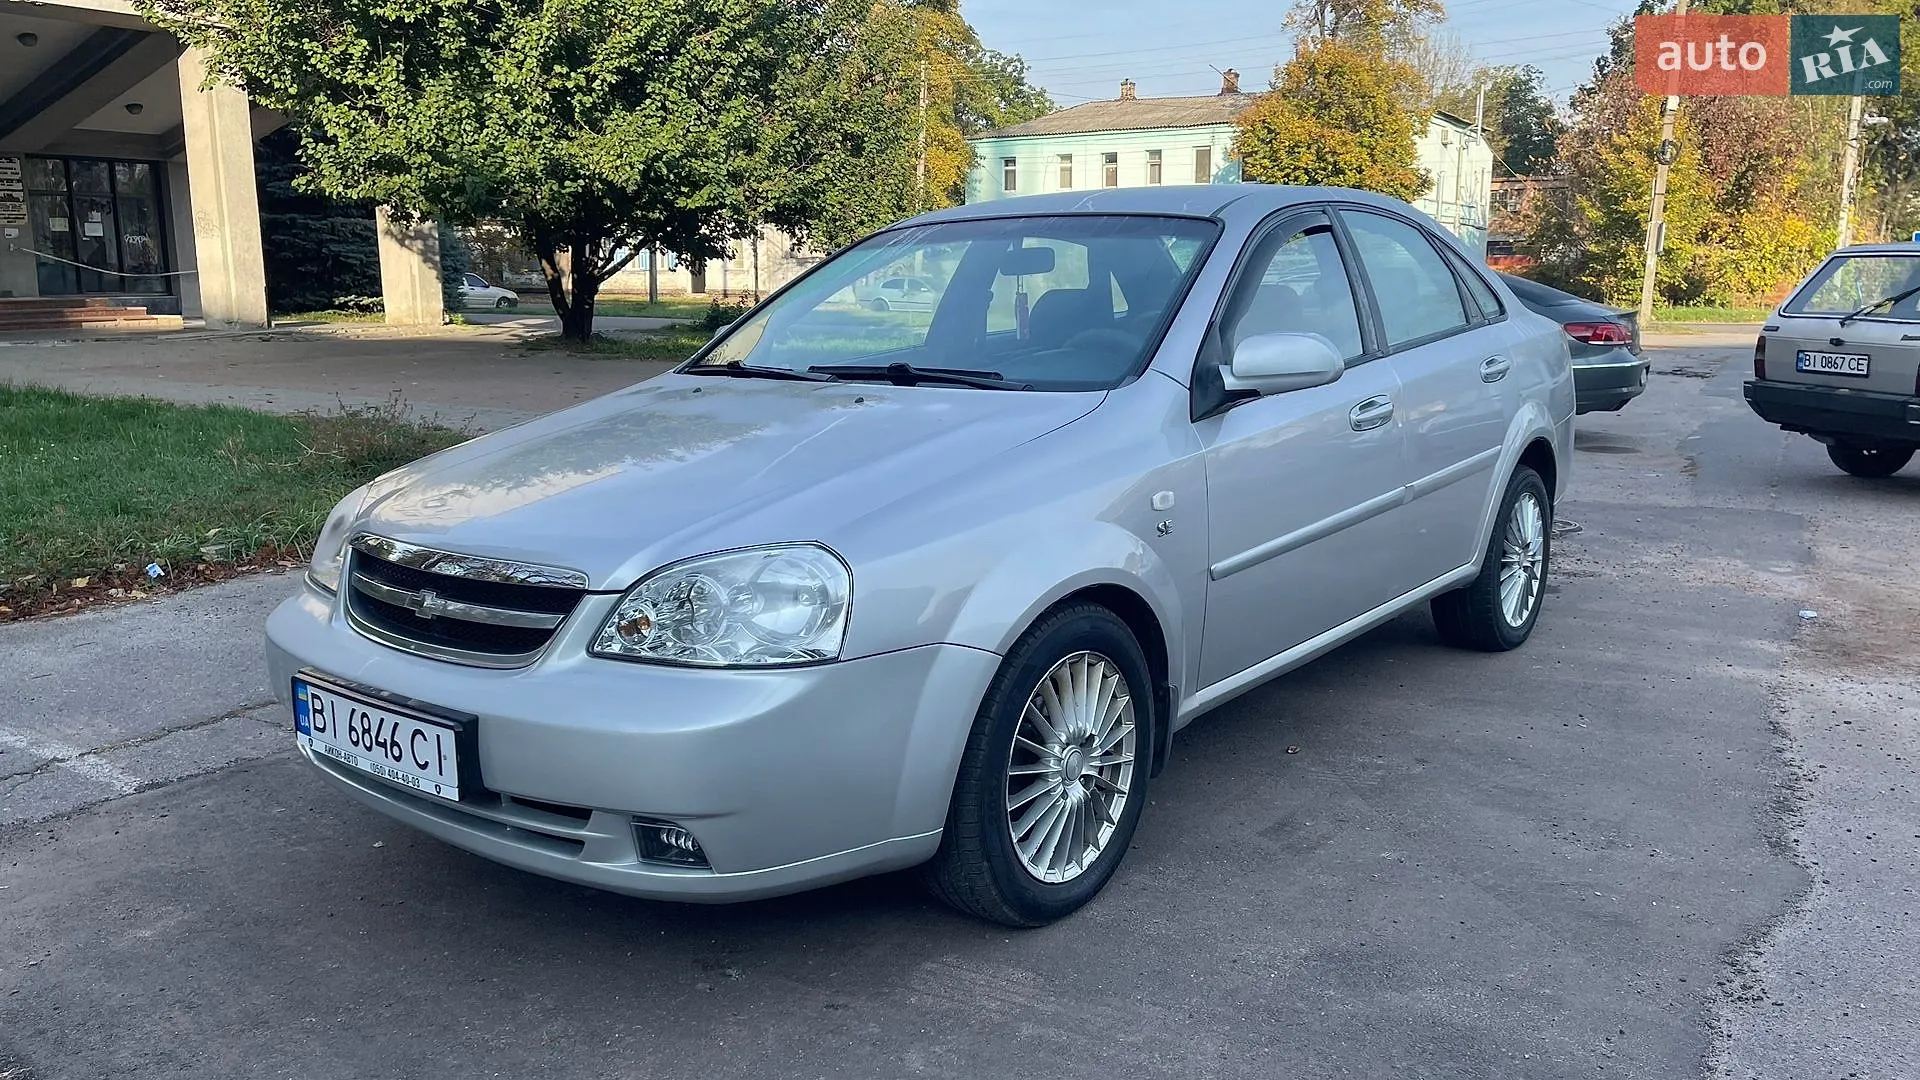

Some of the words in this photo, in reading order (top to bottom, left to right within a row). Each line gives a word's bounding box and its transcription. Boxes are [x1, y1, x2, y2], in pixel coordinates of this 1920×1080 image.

[1804, 353, 1816, 368] BI
[1821, 355, 1846, 370] 0867
[1848, 357, 1868, 372] CE
[300, 714, 310, 728] UA
[311, 692, 337, 739] BI
[348, 707, 403, 763] 6846
[410, 728, 443, 776] CI
